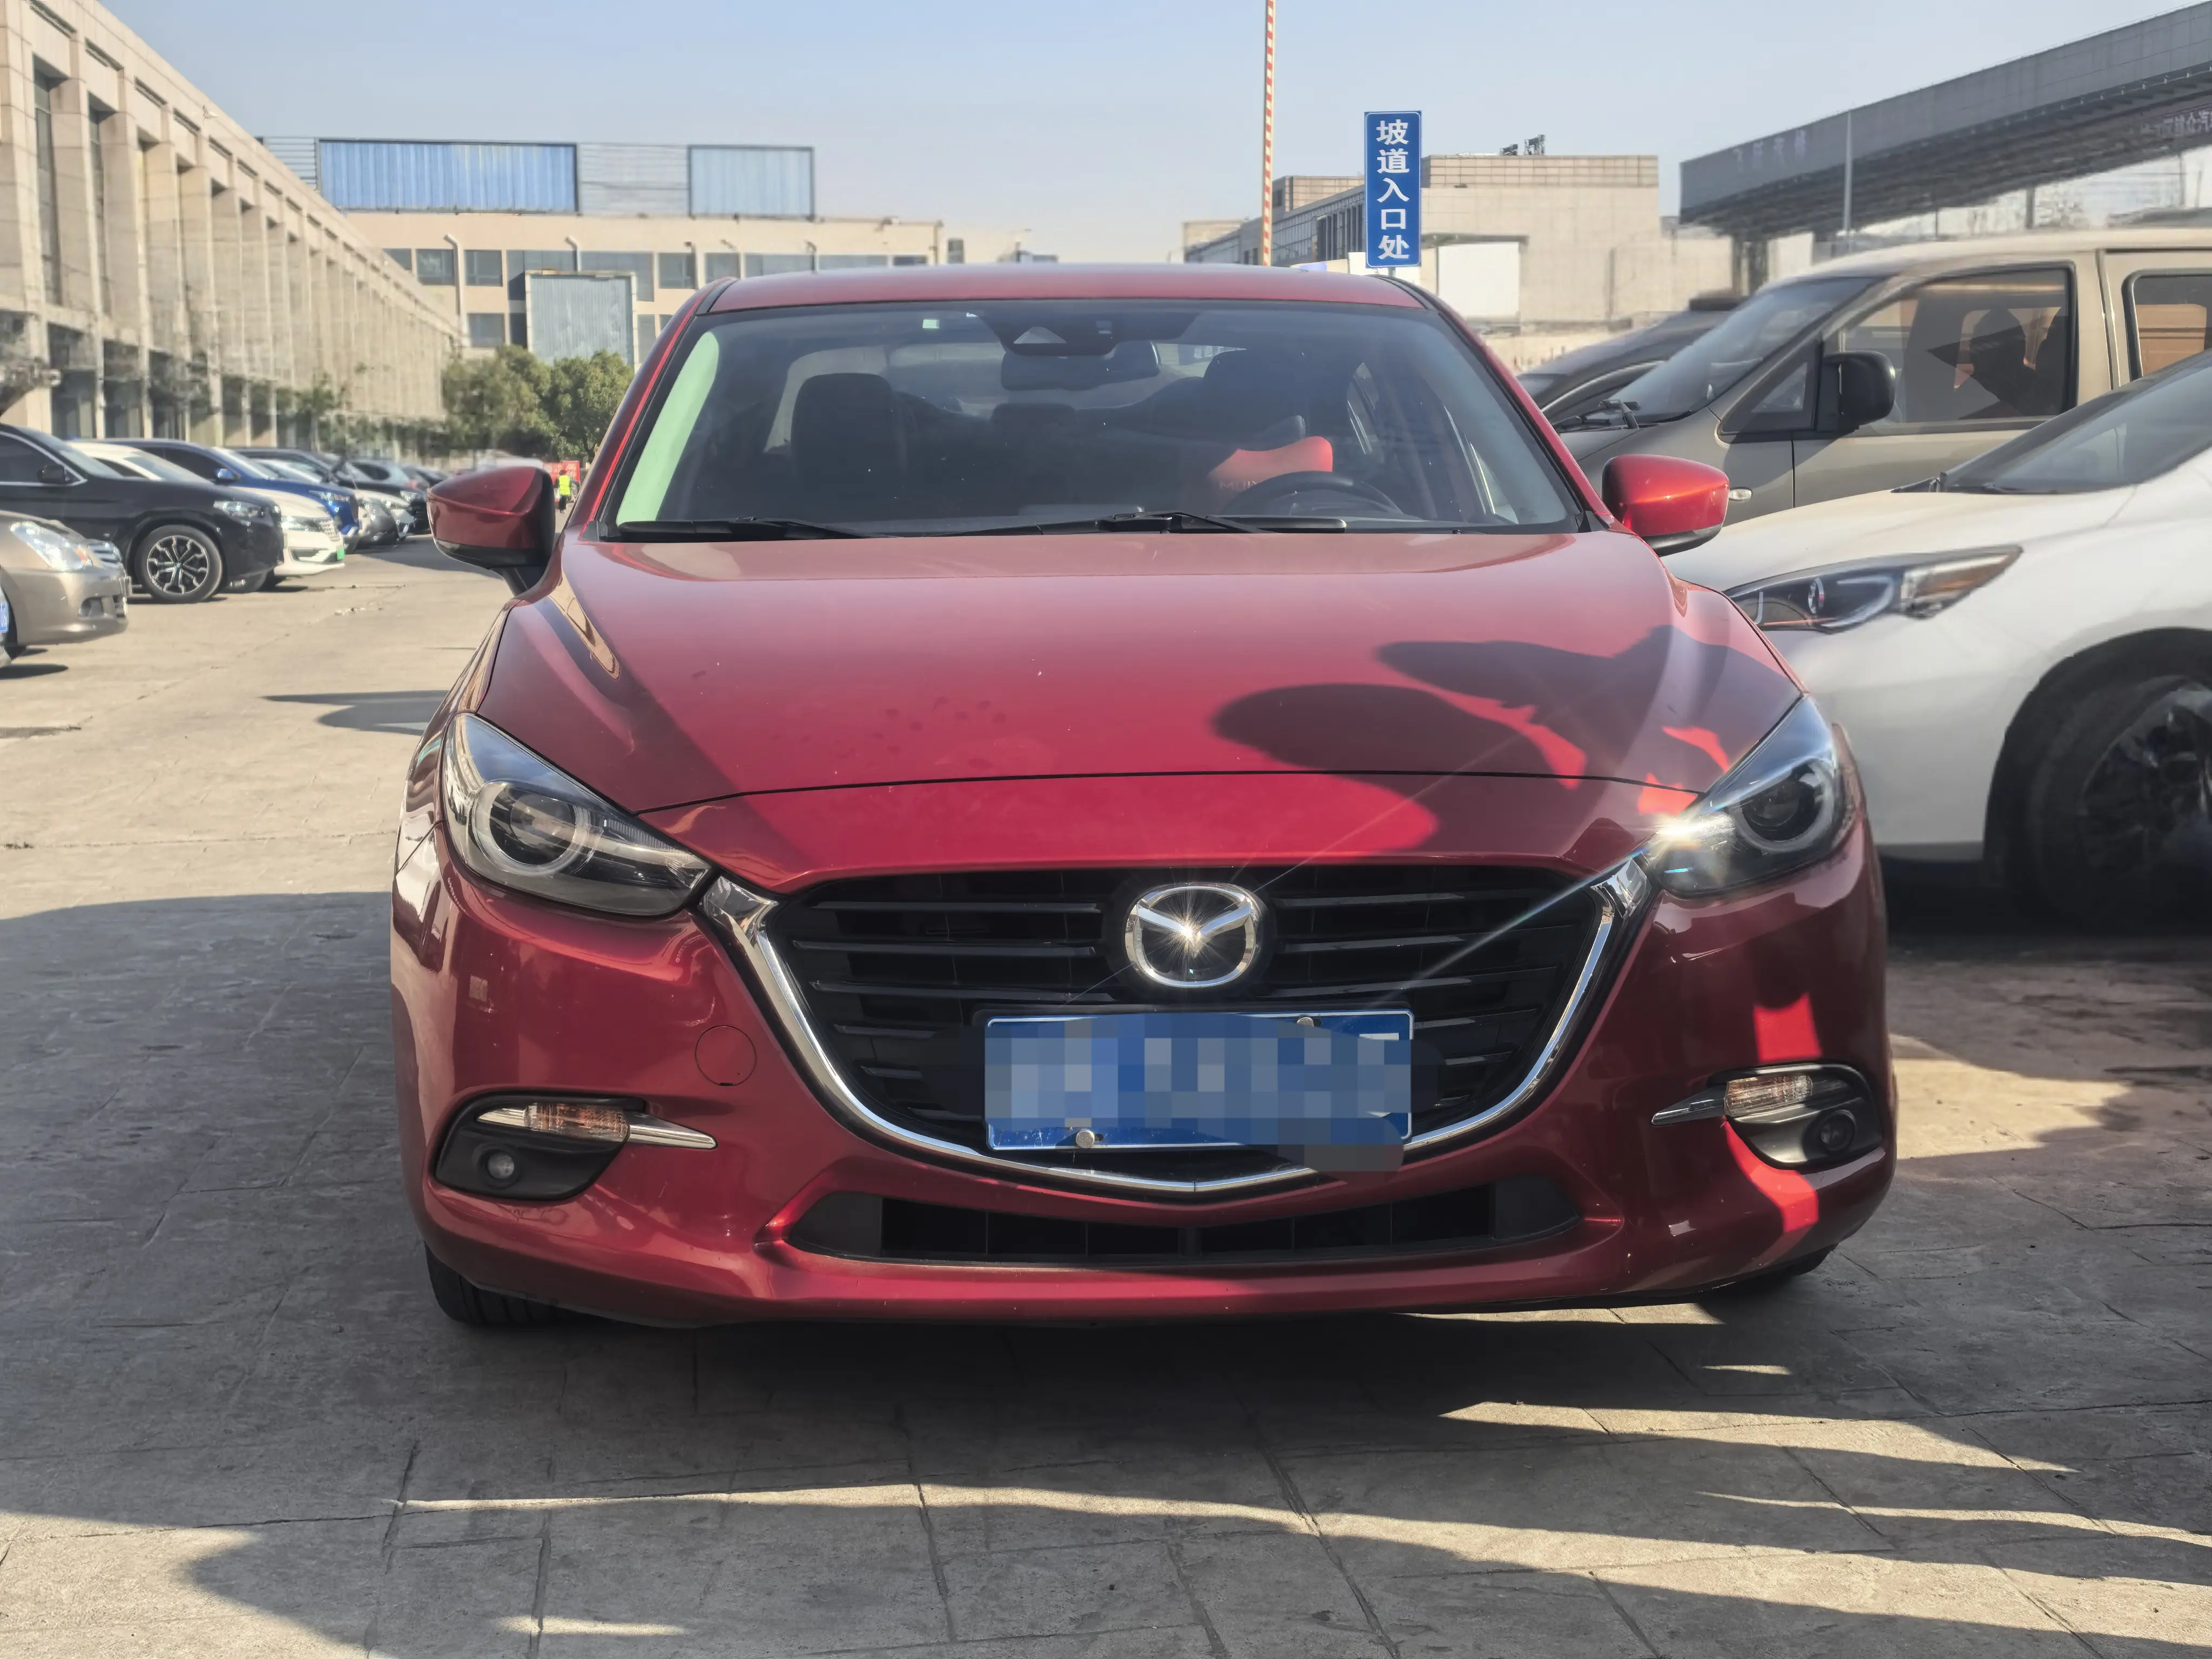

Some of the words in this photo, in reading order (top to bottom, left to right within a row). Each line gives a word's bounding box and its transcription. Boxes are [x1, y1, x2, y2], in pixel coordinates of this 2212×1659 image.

[1376, 119, 1410, 260] 坡道入口处
